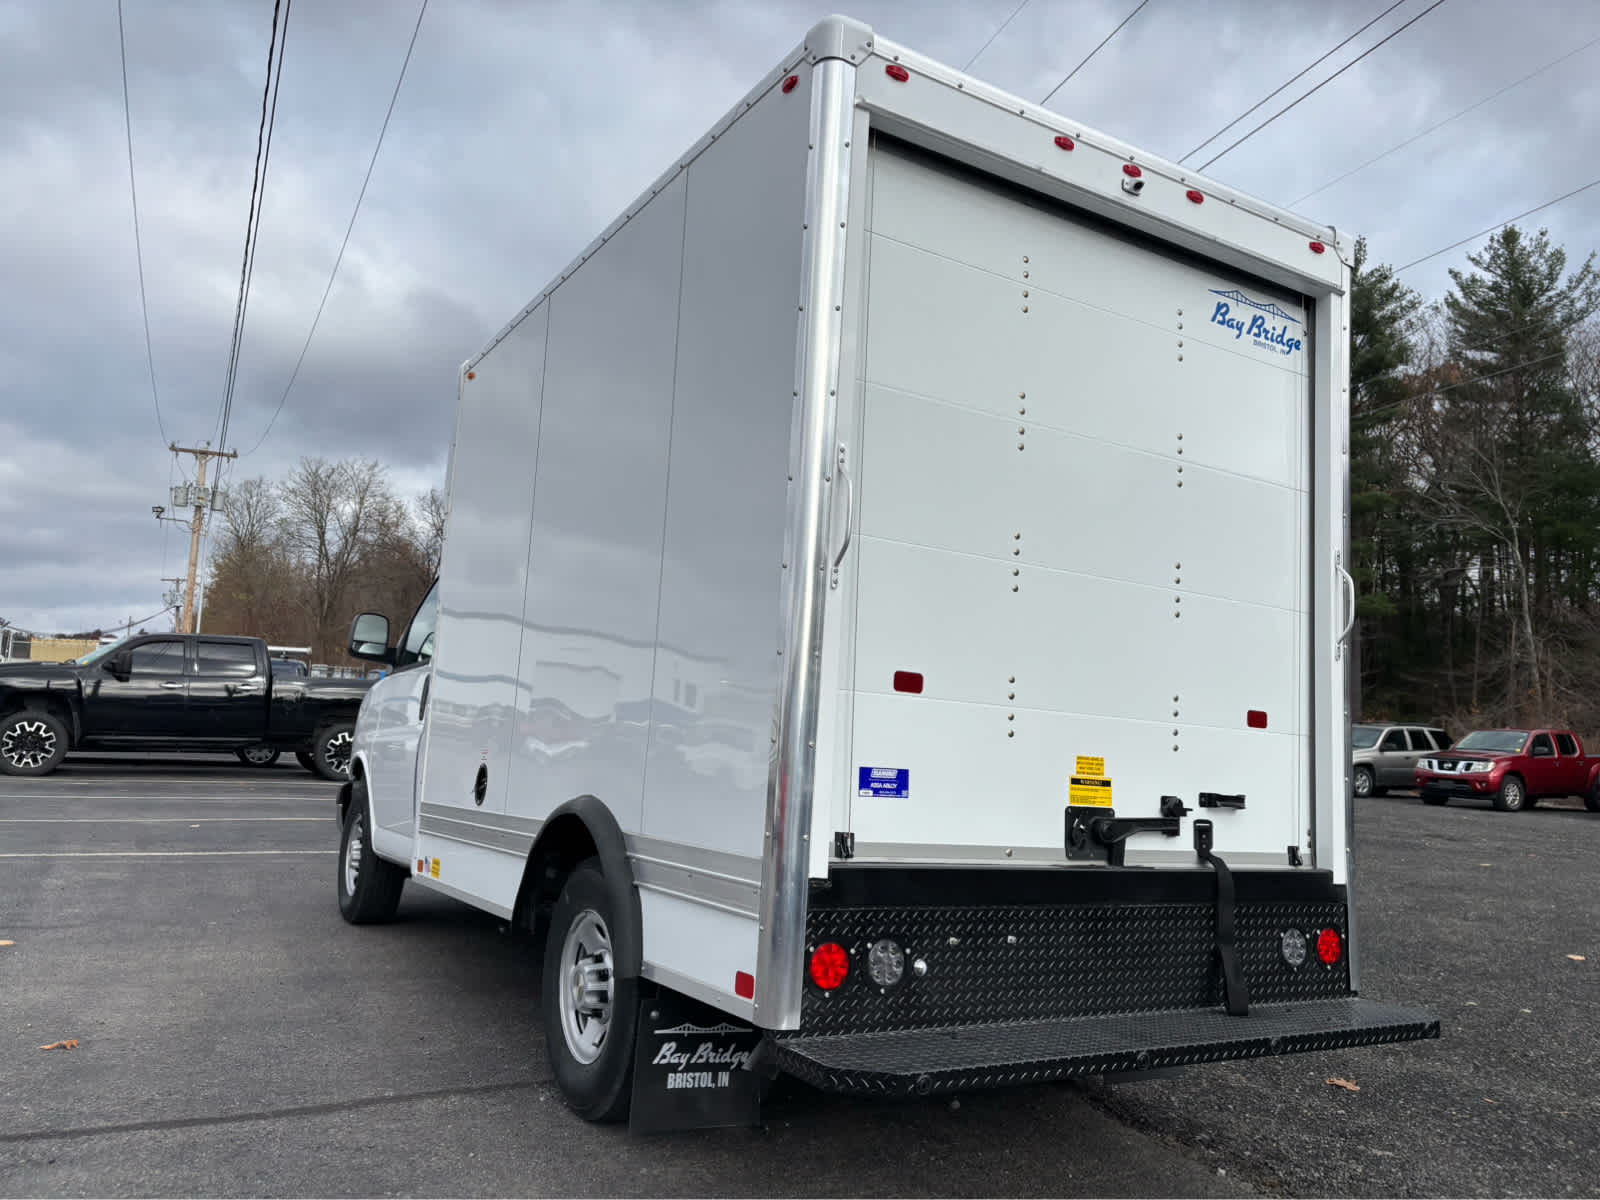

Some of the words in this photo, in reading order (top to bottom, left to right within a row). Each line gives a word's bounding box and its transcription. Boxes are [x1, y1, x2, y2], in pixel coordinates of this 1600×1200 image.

[1210, 301, 1245, 339] Bay
[1246, 314, 1302, 355] Bridge
[652, 1041, 690, 1071] Bay
[667, 1072, 715, 1089] BRISTOL,
[717, 1072, 730, 1088] IN
